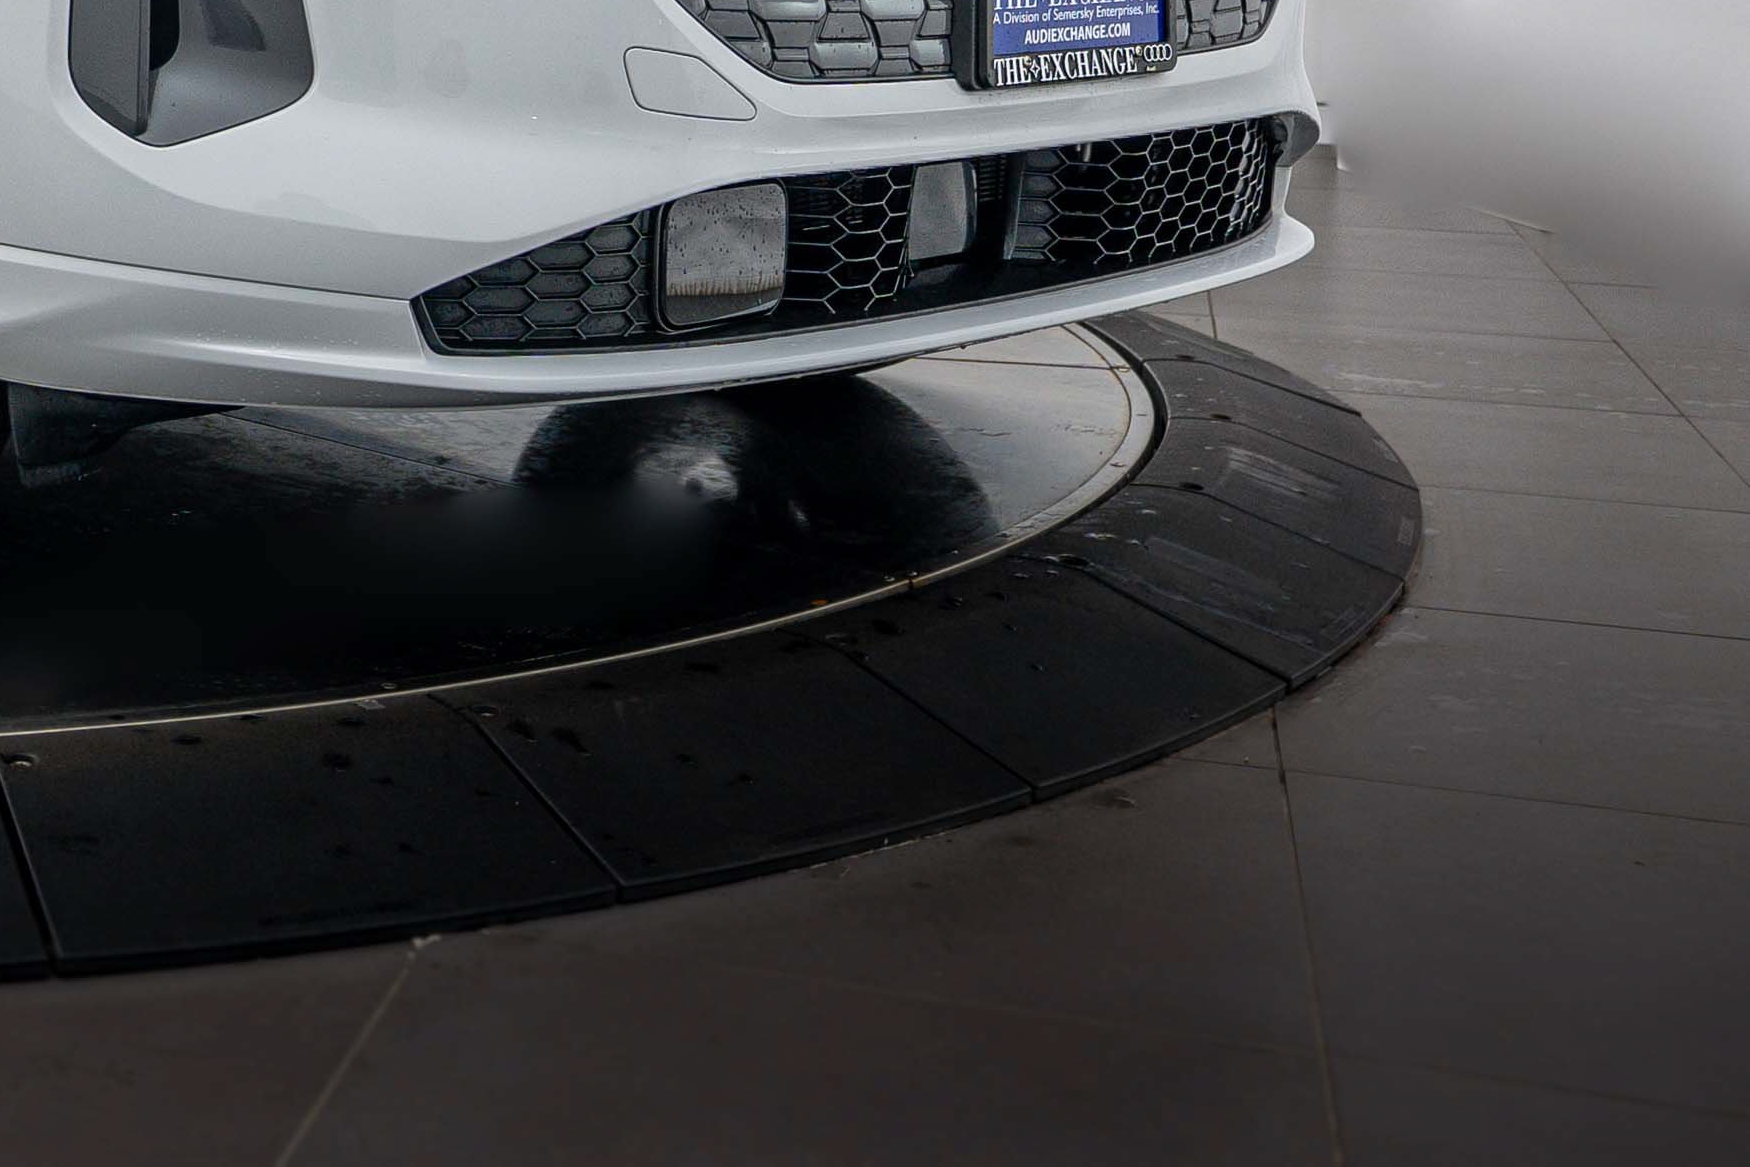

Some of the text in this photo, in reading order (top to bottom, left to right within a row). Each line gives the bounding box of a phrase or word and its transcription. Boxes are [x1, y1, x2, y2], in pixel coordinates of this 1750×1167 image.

[993, 2, 1160, 25] A Division of Semersky Enterprises, Inc.
[1024, 22, 1131, 45] AUDIEXCHANGE.COM
[993, 46, 1138, 86] THE EXCHANGE
